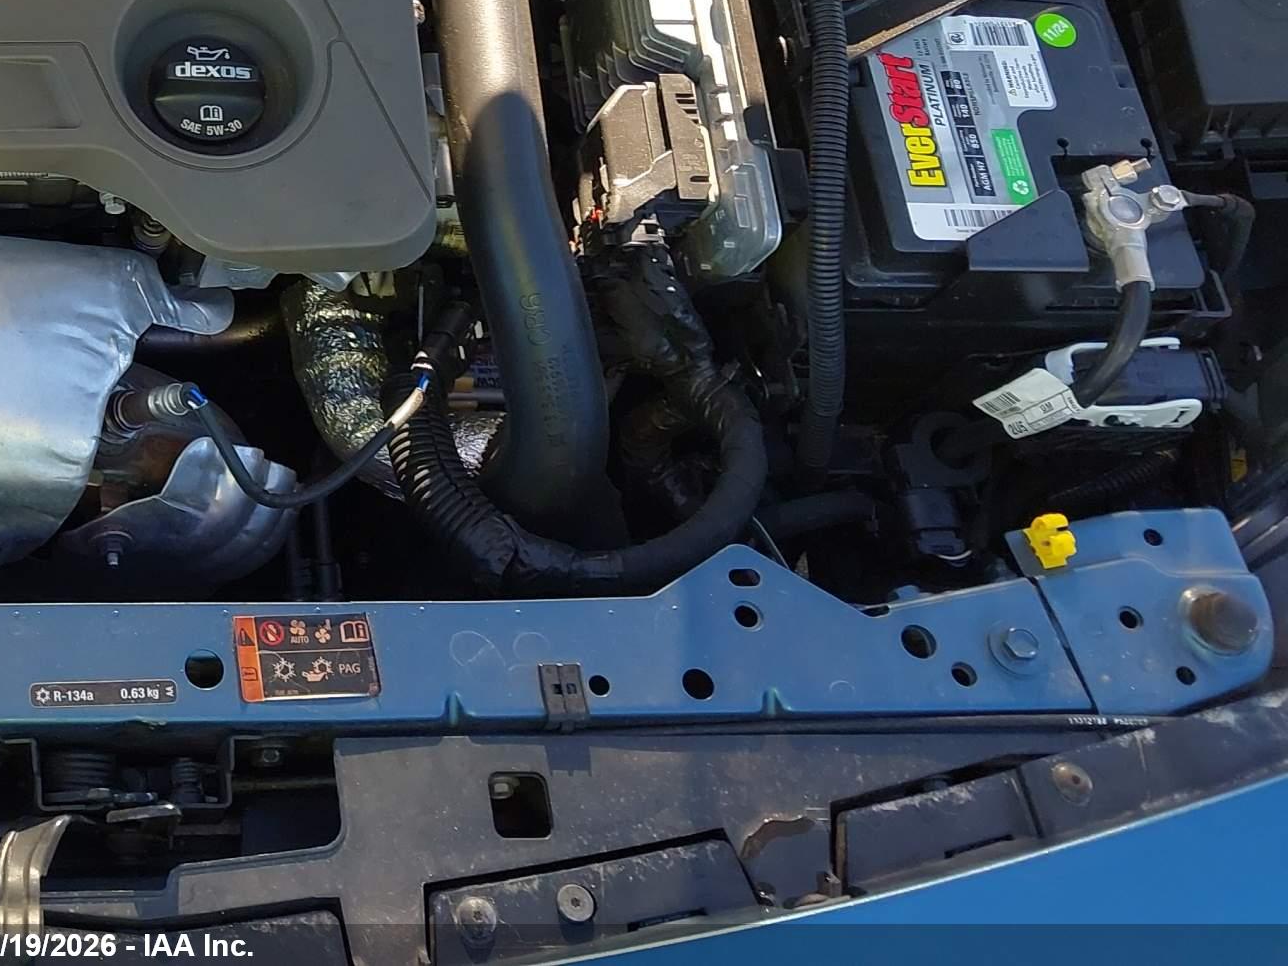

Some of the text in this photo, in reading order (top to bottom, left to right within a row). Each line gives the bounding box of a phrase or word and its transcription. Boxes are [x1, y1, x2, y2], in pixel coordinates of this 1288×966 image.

[1044, 19, 1069, 42] 11/24
[175, 61, 253, 79] dexos
[919, 64, 947, 127] PLATINUM
[876, 50, 948, 188] EverStart
[960, 104, 970, 118] 140
[180, 119, 243, 136] SAE 5W-30
[976, 160, 992, 191] AGM H7
[290, 635, 309, 644] AUTO
[338, 663, 361, 675] PAG
[53, 686, 159, 702] R-134a 0.63 kg
